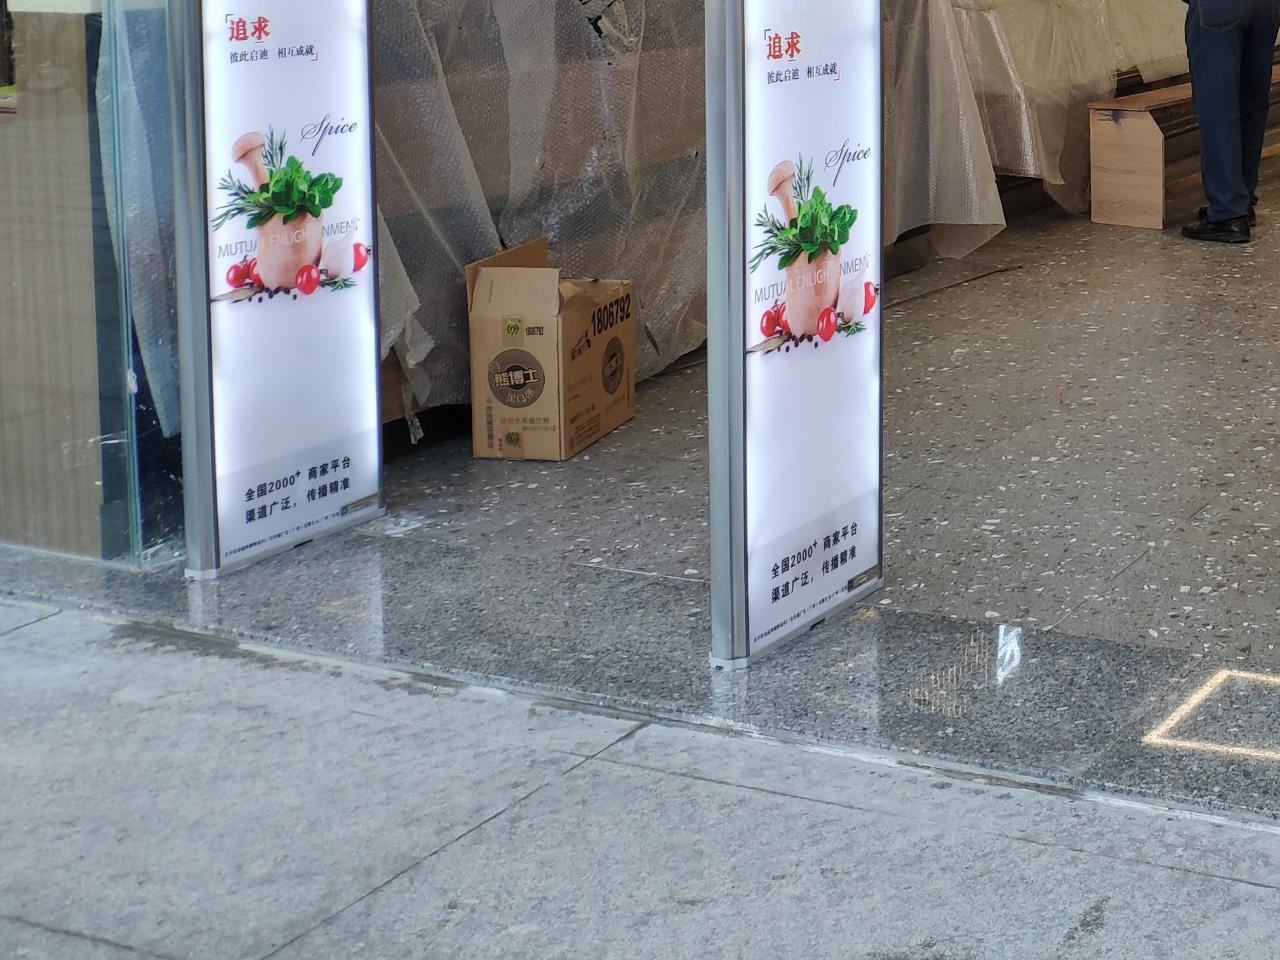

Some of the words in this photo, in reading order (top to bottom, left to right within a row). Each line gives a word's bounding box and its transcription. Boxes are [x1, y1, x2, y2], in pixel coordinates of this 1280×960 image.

[228, 16, 271, 42] 追求
[229, 49, 269, 63] 彼此启迪
[277, 45, 316, 59] 相互成就
[766, 31, 802, 60] 追求
[767, 67, 800, 84] 彼此启迪
[807, 62, 838, 79] 相互成就
[300, 112, 359, 157] Spice
[824, 138, 872, 187] Spice
[591, 293, 631, 338] 1806792
[308, 456, 351, 481] 商家平台
[306, 478, 351, 502] 传播精准
[823, 521, 858, 551] 商家平台
[821, 545, 857, 576] 传播精准
